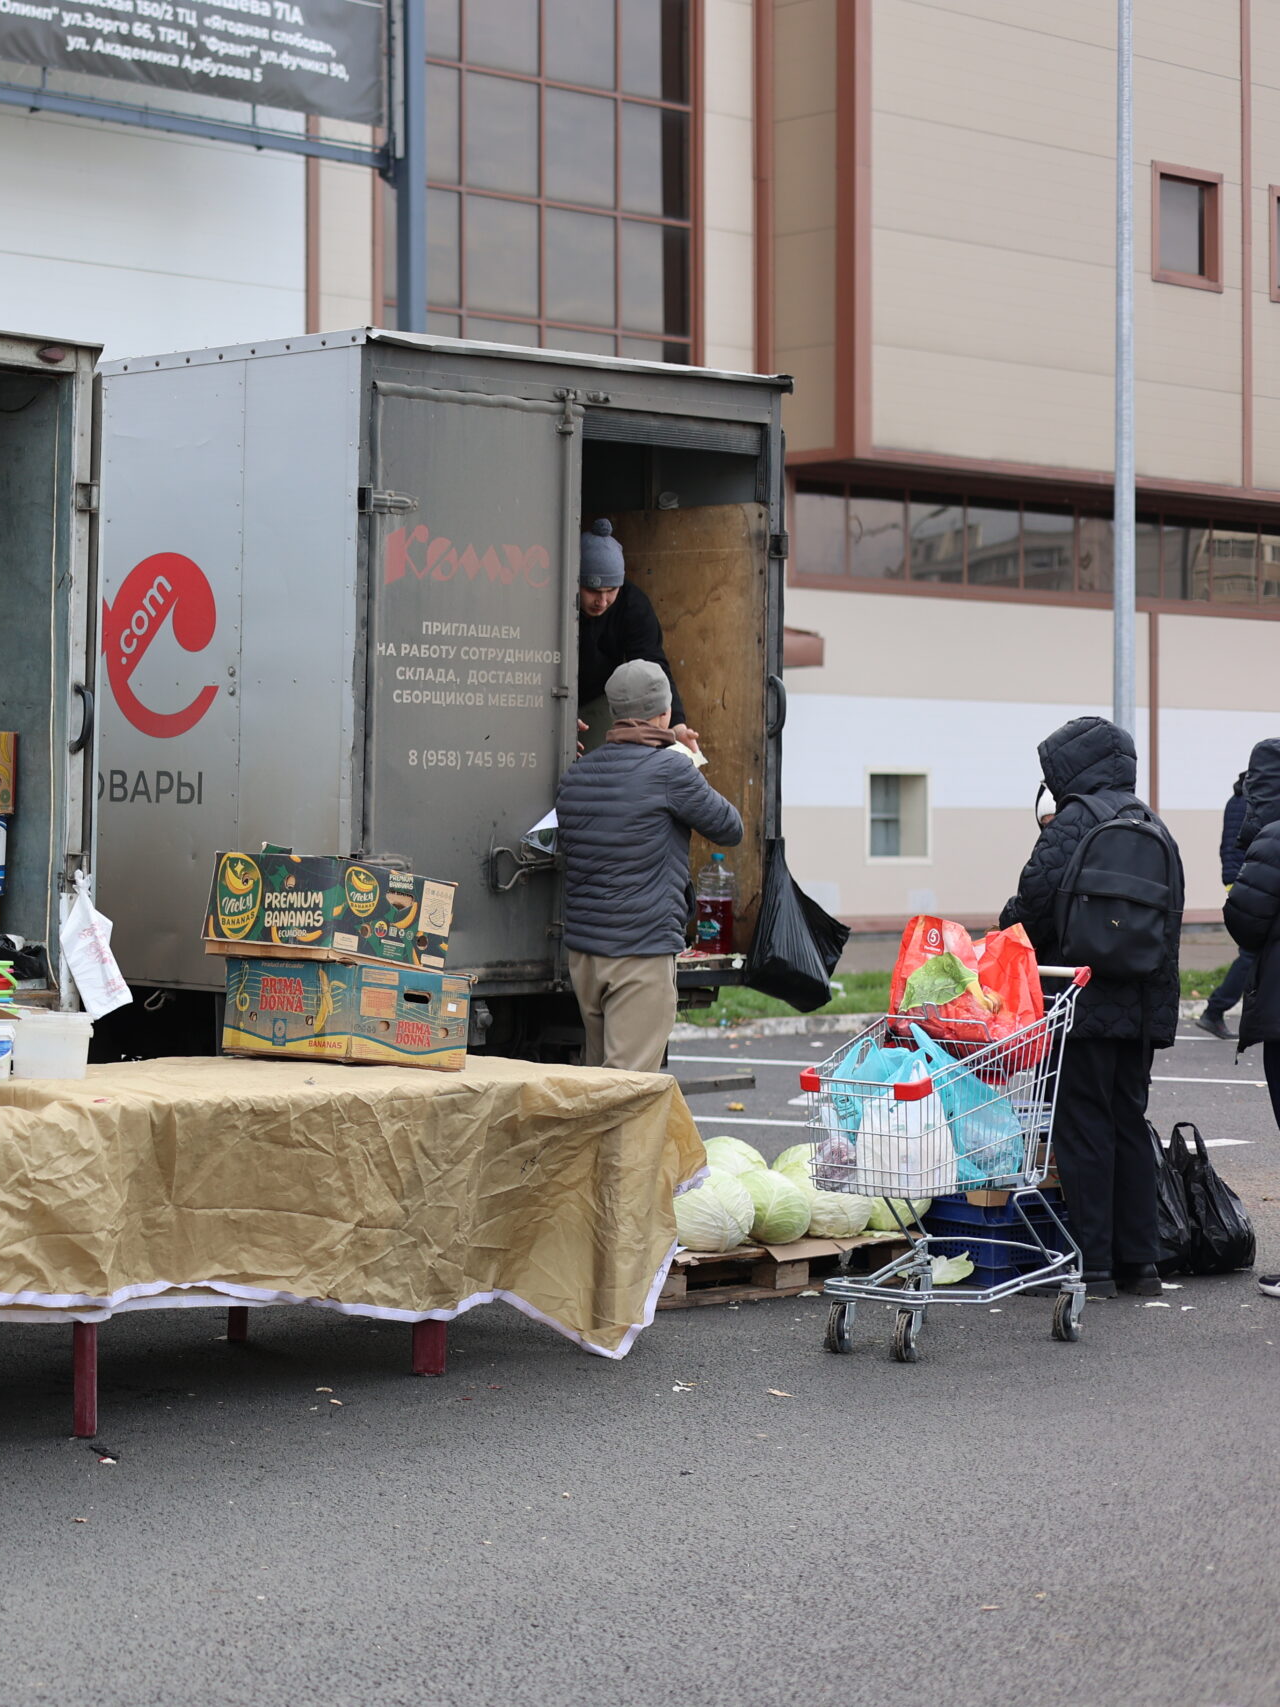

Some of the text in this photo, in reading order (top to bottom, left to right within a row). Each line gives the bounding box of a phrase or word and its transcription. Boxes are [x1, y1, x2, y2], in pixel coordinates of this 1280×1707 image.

[61, 8, 130, 34] ул.Зорге
[131, 20, 156, 42] 66,
[200, 34, 259, 58] "Франт"
[176, 8, 198, 28] ТЦ
[203, 15, 270, 41] «Ягодная
[66, 34, 263, 83] ул. Академика Арбузова 5
[120, 575, 173, 665] .com
[422, 621, 520, 640] ПРИГЛАШАЕМ
[377, 642, 561, 664] НА РАБОТУ СОТРУДНИКОВ
[396, 666, 542, 686] СКЛАДА, ДОСТАВКИ
[393, 690, 544, 708] СБОРЩИКОВ МЕБЕЛИ
[408, 750, 537, 770] 8 (958) 745 96 75
[389, 873, 414, 883] PREMIUM
[389, 881, 414, 890] BANANAS
[221, 893, 253, 915] Vicky
[264, 891, 324, 909] PREMIUM
[350, 891, 374, 902] Vicky
[350, 901, 375, 910] BANANAS
[221, 912, 255, 926] BANANAS
[264, 910, 324, 928] BANANAS
[278, 929, 307, 938] ECUADOR
[261, 976, 304, 996] PRIMA
[259, 994, 305, 1013] DONNA
[396, 1020, 432, 1036] PRIMA
[308, 1040, 342, 1049] BANANAS
[395, 1033, 431, 1048] DONNA
